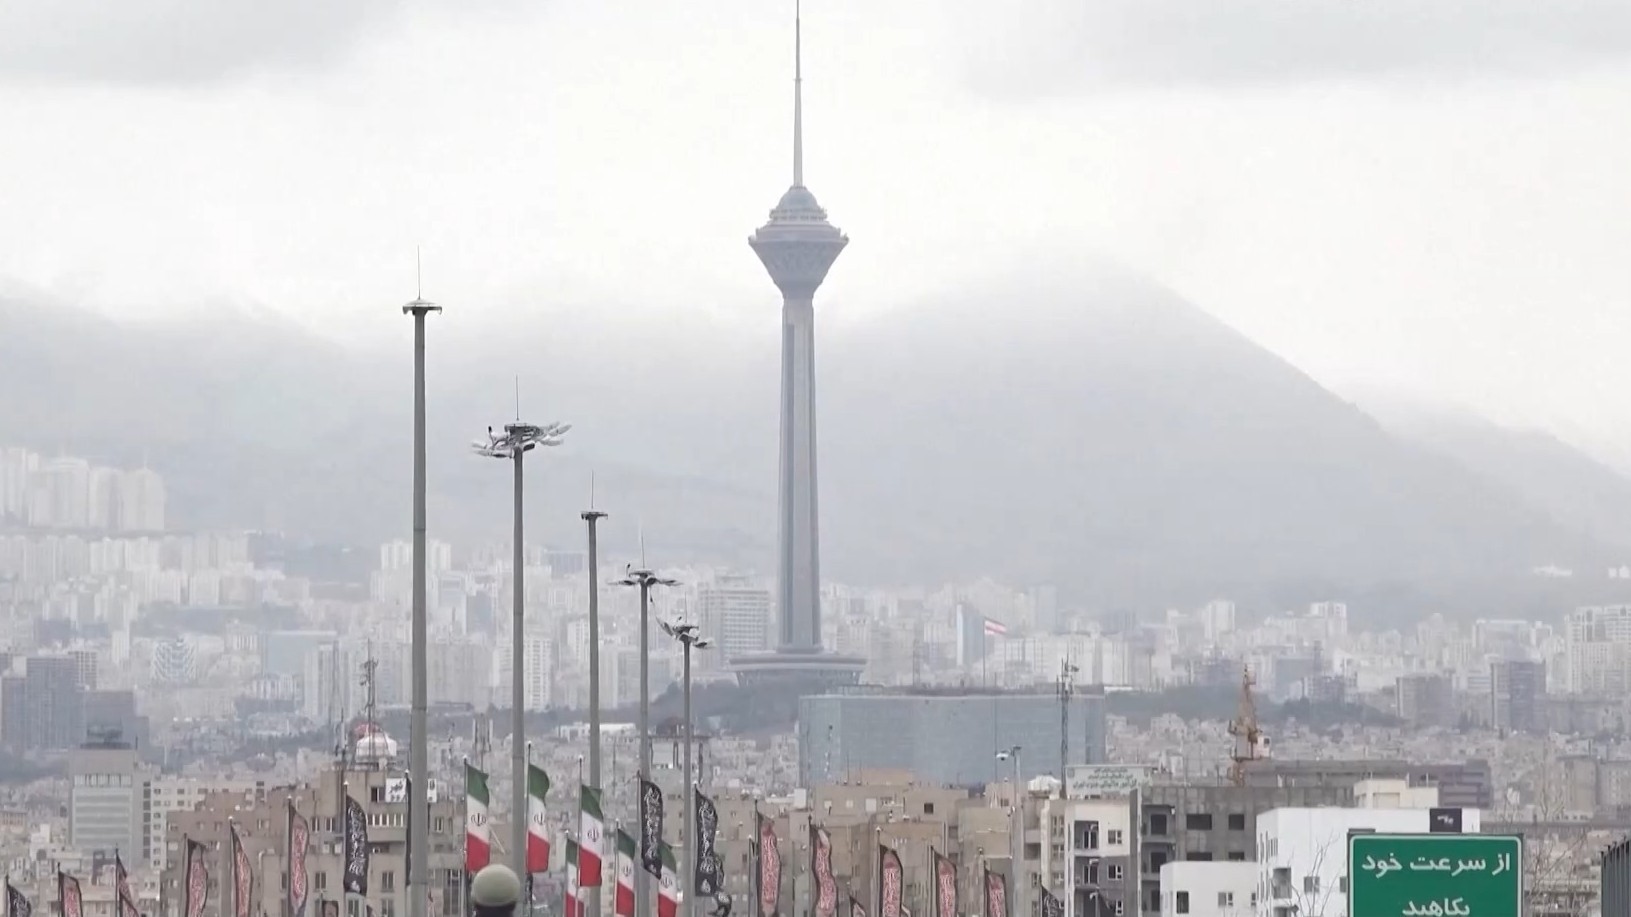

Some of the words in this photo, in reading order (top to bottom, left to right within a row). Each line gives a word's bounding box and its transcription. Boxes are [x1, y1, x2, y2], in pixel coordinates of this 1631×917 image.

[1361, 852, 1403, 879] خود
[1409, 855, 1487, 877] سرعت
[1491, 853, 1510, 876] از
